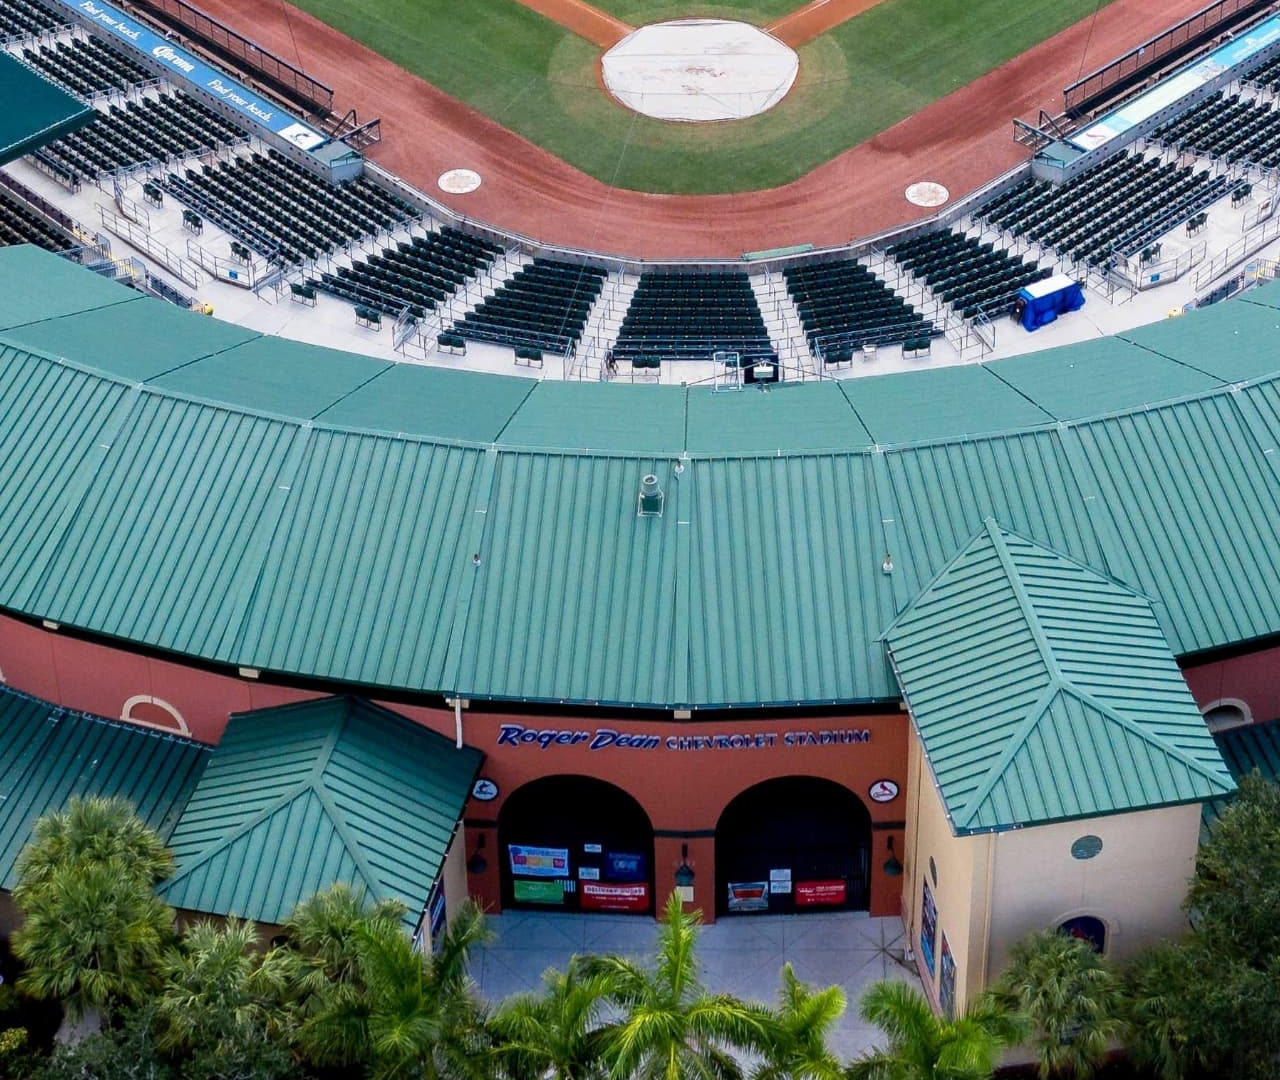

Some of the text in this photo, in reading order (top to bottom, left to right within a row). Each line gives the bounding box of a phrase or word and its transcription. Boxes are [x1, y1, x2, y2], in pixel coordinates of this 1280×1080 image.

[80, 1, 104, 16] Find
[93, 13, 119, 26] your
[115, 22, 141, 41] beach
[152, 45, 274, 122] Corona Find your beach
[496, 723, 870, 752] Roger Dean CHEVROLET STADIUM
